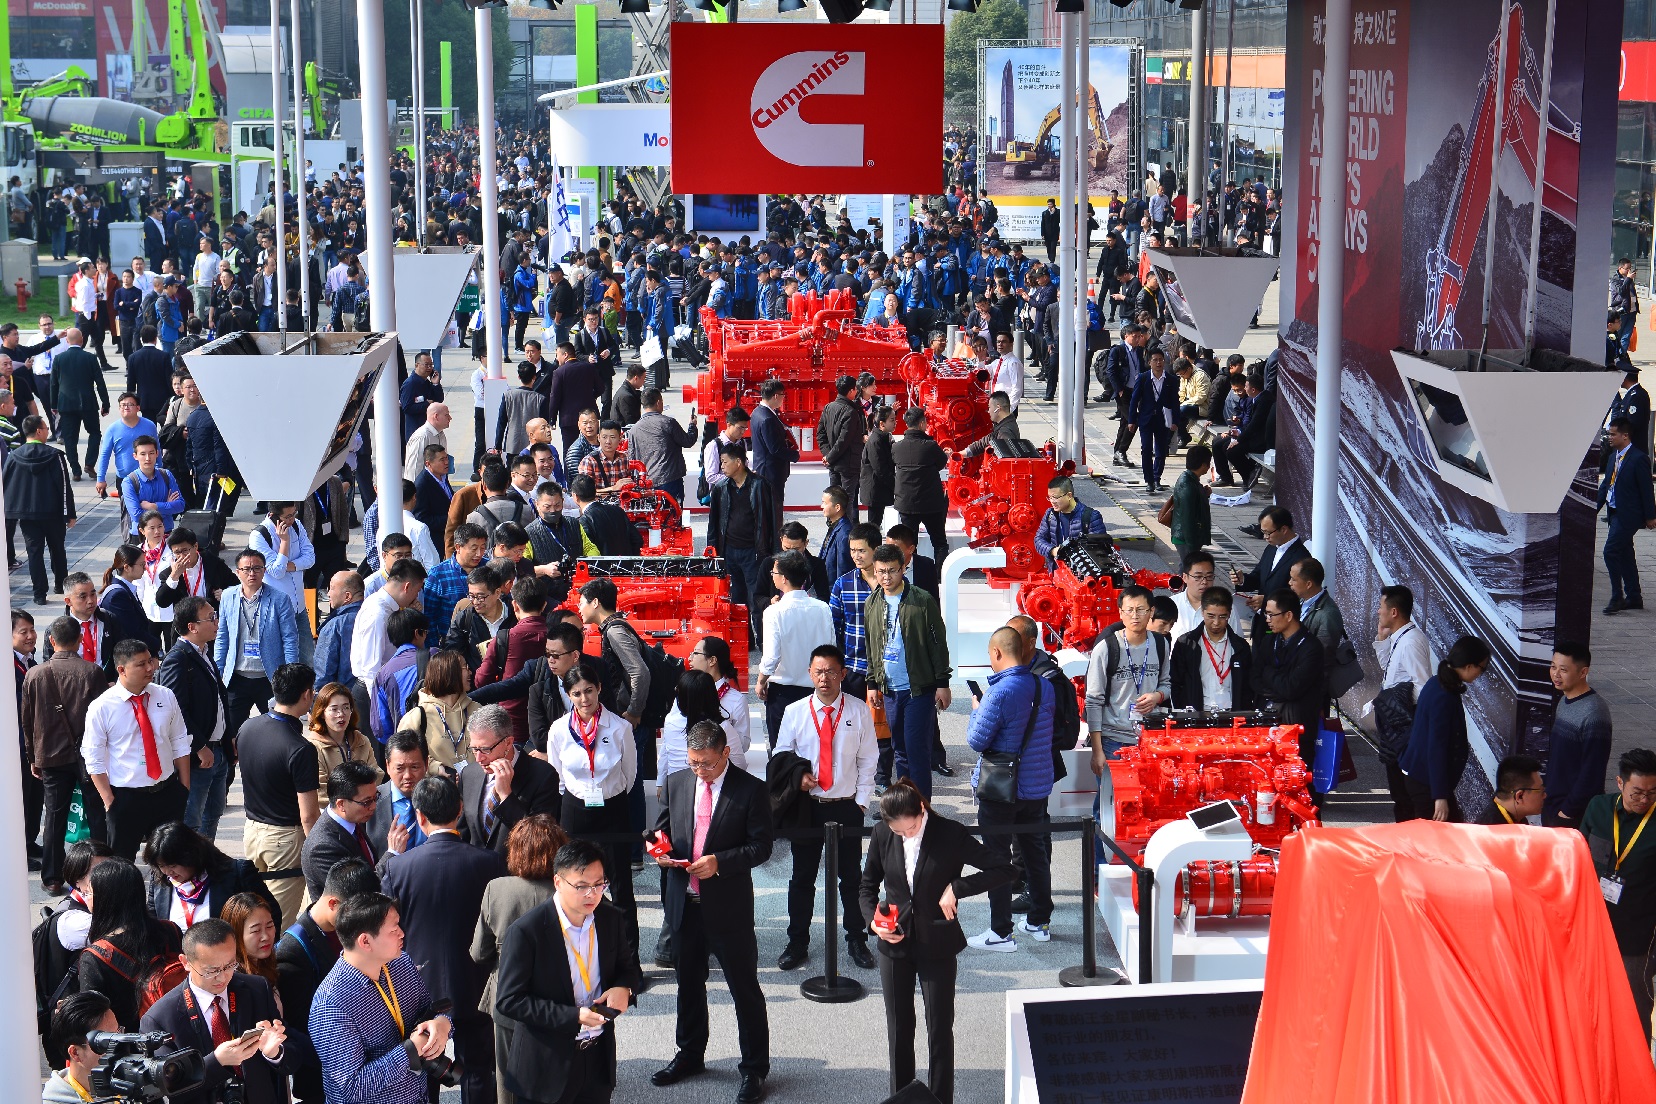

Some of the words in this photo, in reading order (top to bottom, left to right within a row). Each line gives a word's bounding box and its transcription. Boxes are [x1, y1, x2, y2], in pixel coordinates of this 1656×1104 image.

[33, 2, 87, 10] McDonald's
[752, 50, 850, 129] Cummins
[1312, 69, 1394, 116] PERING
[70, 123, 127, 143] ZOOMLION
[643, 132, 671, 147] Mo
[229, 991, 237, 1013] PENTAX
[1055, 1083, 1243, 1104] 我们一起见证康明斯非道路
